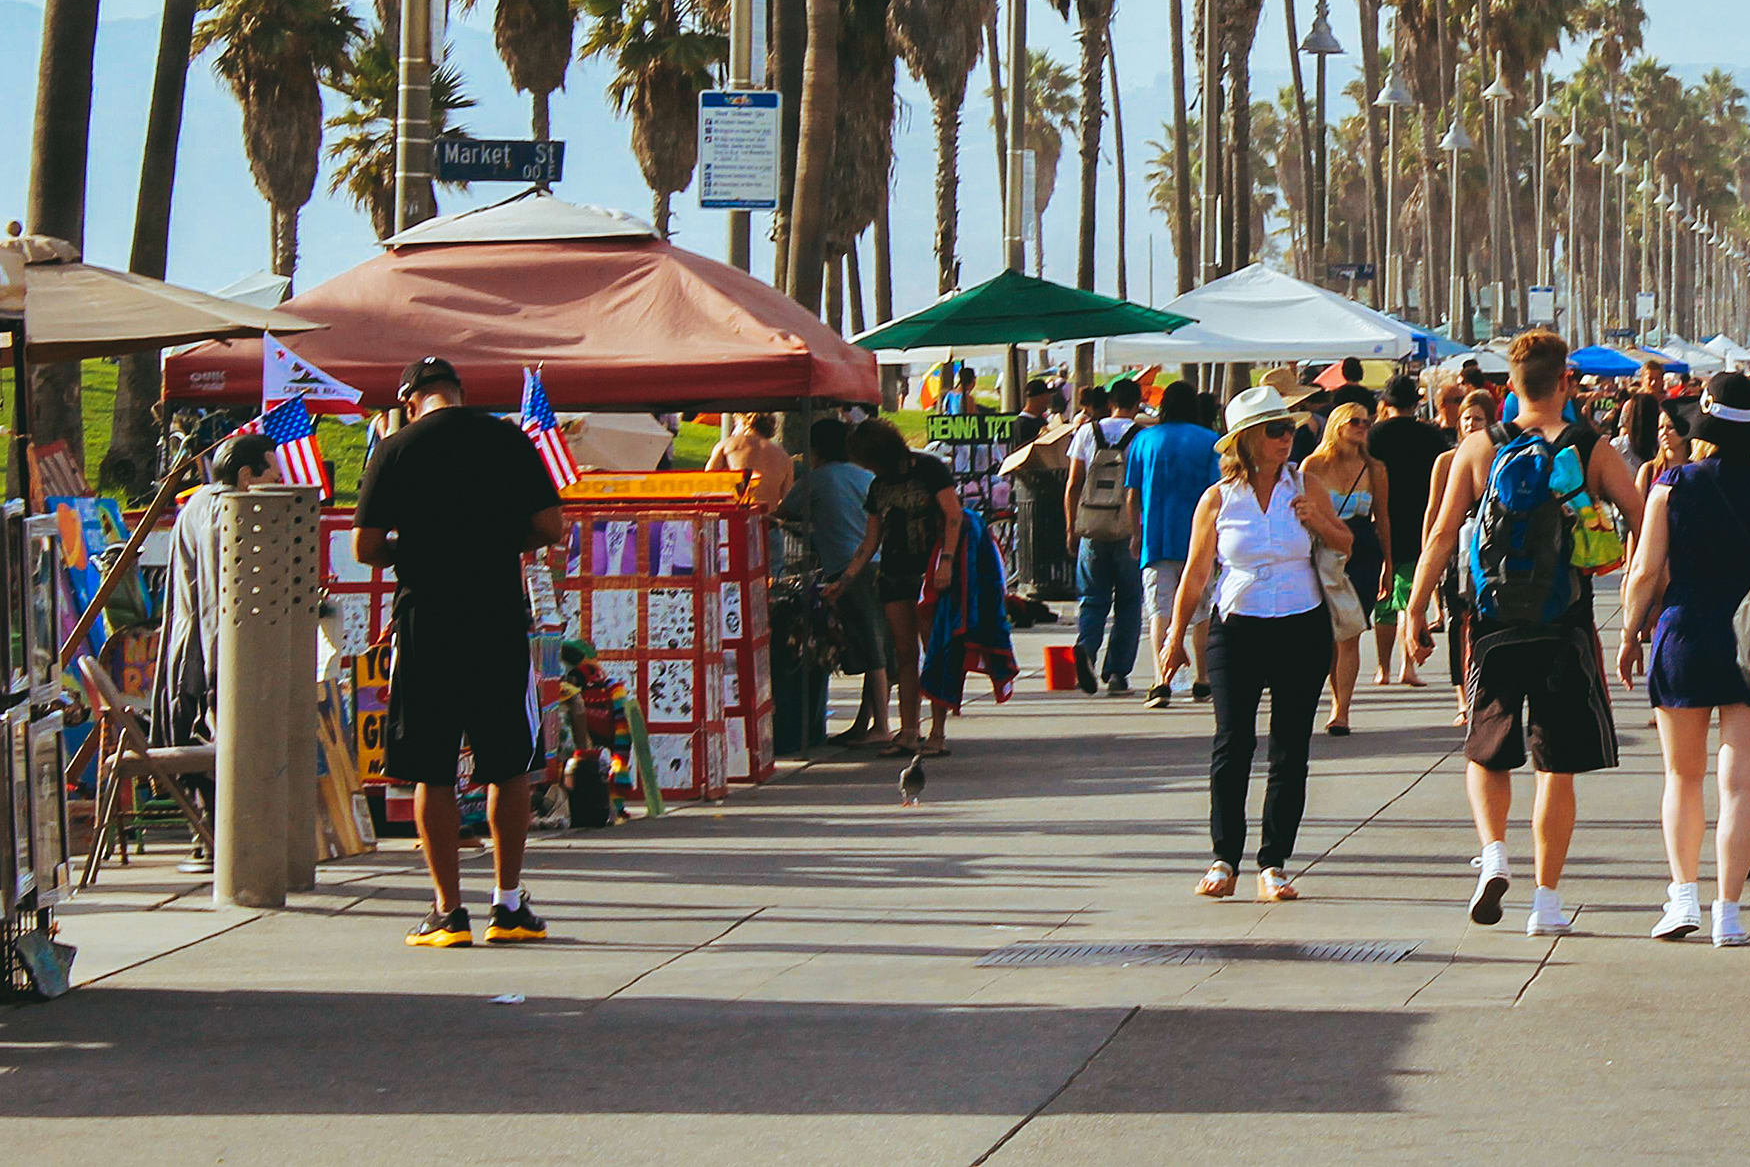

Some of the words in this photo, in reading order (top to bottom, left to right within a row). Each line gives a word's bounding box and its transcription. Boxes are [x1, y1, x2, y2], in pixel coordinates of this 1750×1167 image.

[444, 143, 511, 164] Market
[535, 143, 555, 164] St
[522, 164, 541, 179] 00
[547, 165, 556, 179] E
[927, 415, 980, 440] HENNA
